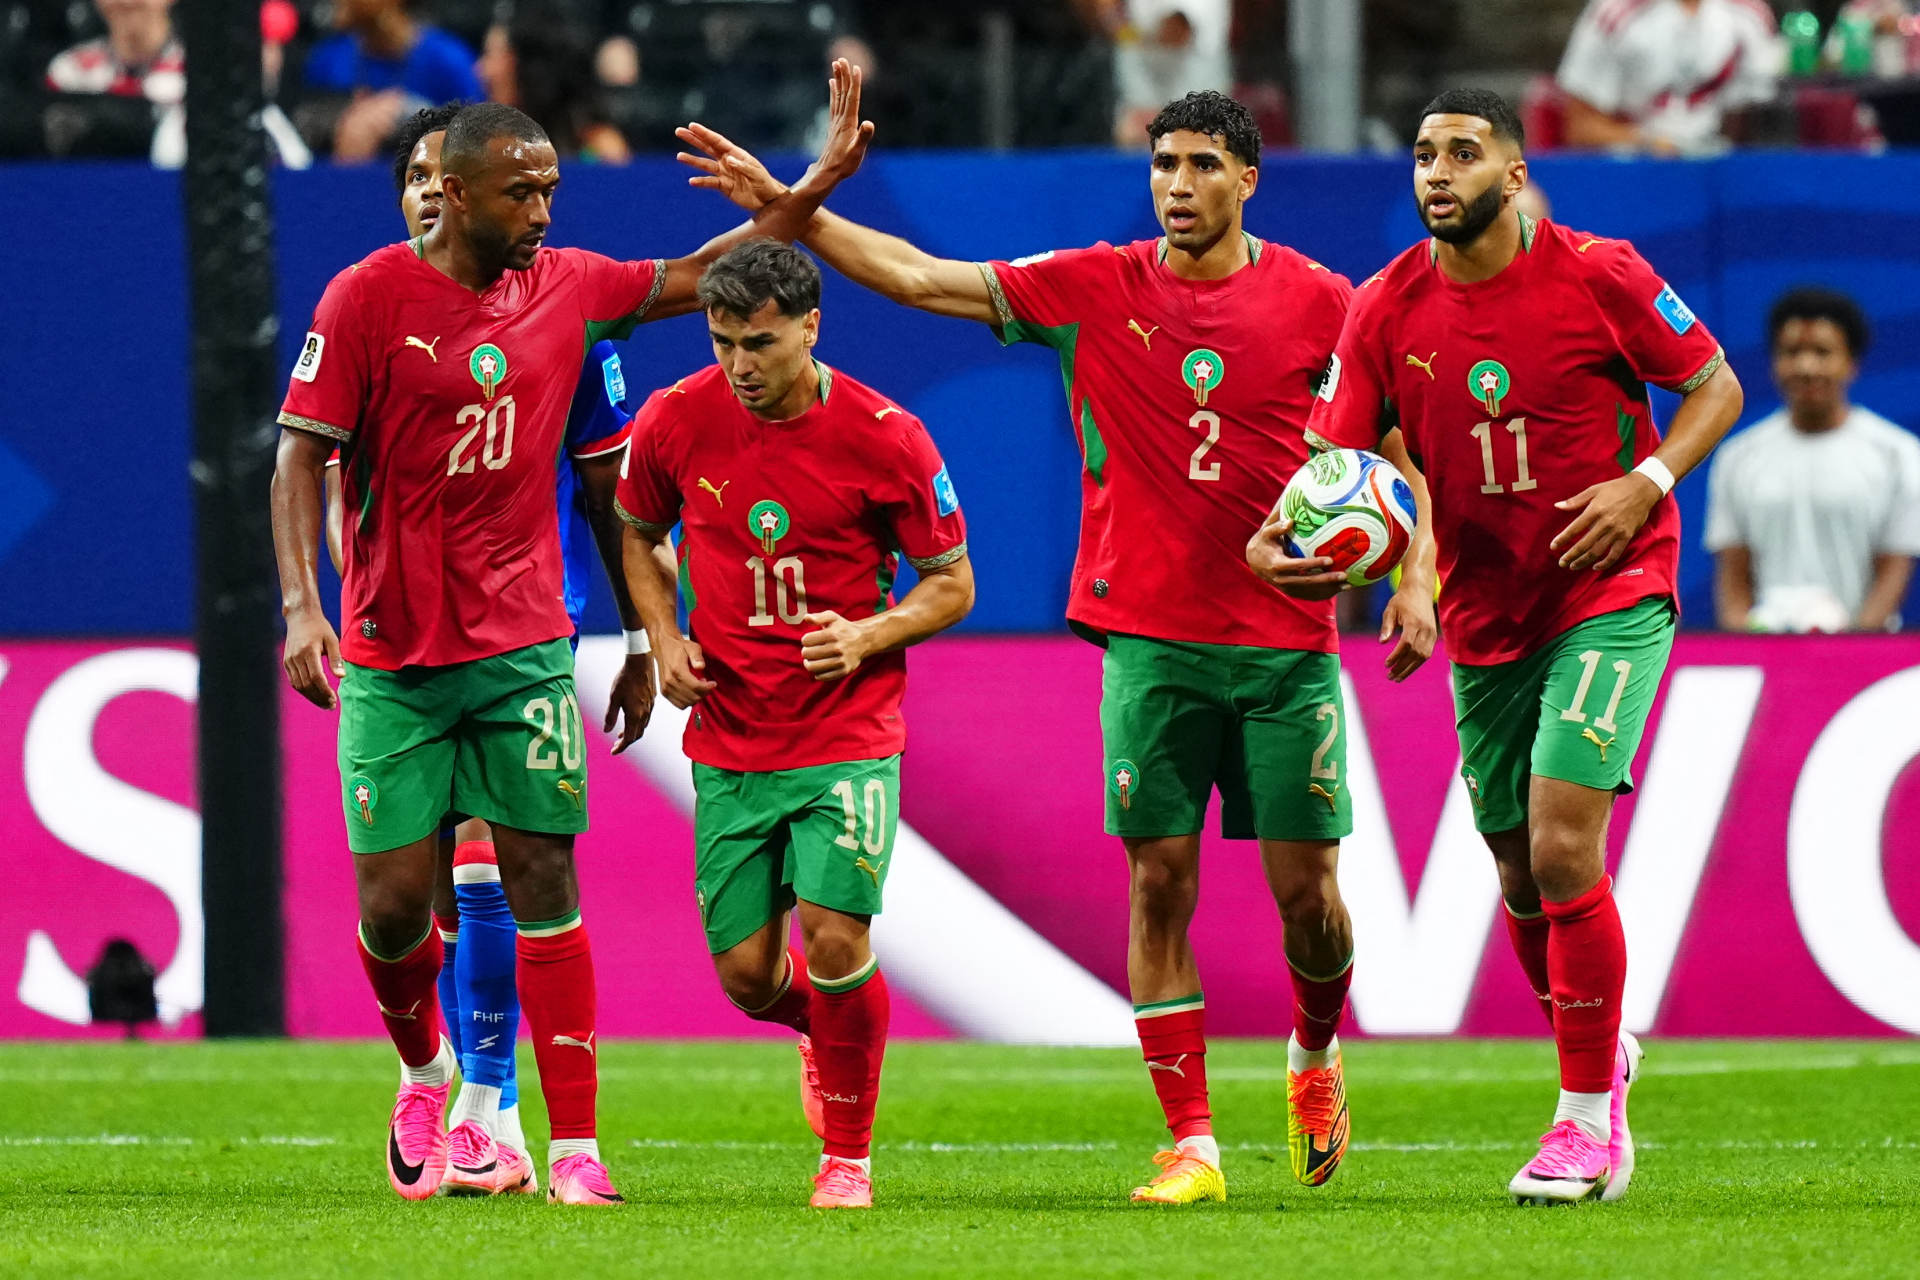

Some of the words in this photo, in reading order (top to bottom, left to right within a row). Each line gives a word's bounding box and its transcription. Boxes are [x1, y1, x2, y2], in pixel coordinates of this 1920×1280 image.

[446, 394, 516, 477] 20
[1188, 410, 1222, 481] 2
[1469, 417, 1538, 495] 11
[744, 555, 808, 627] 10
[1560, 649, 1633, 735] 11
[522, 694, 582, 770] 20
[1310, 702, 1339, 780] 2
[0, 648, 204, 1026] S
[830, 778, 887, 856] 10
[473, 1010, 504, 1023] FHF
